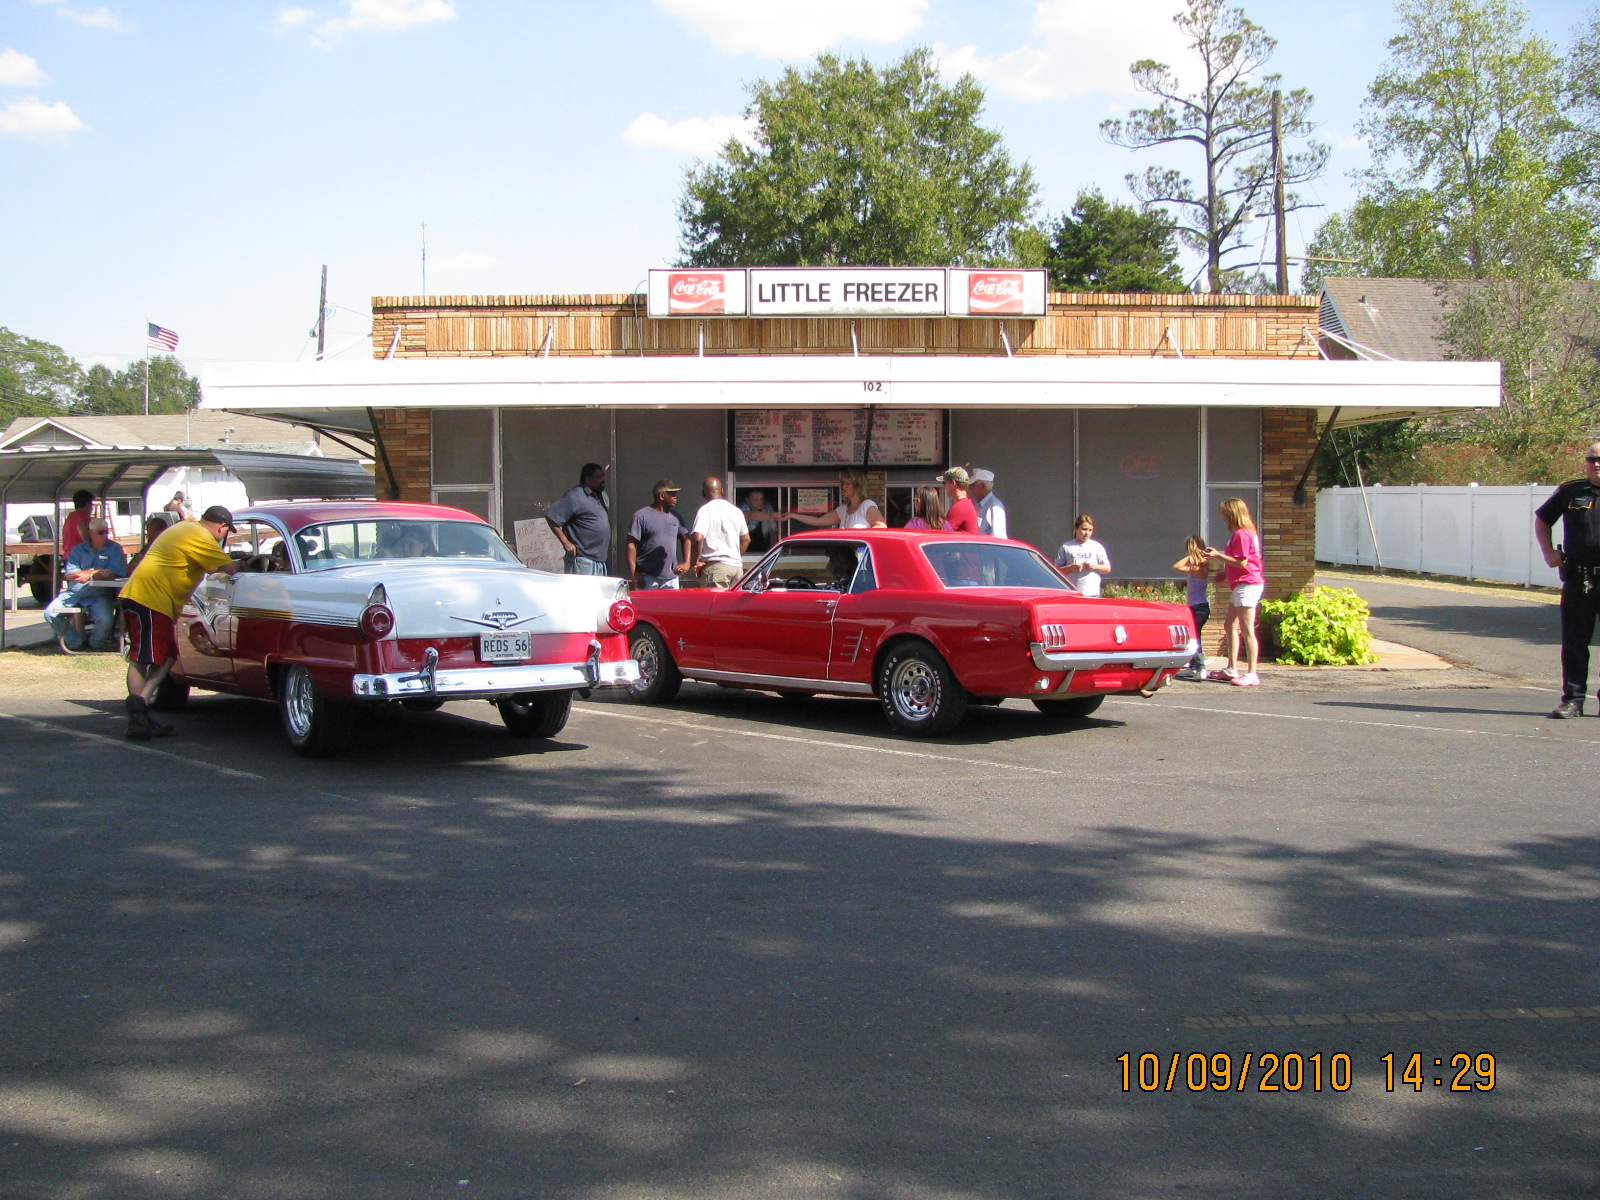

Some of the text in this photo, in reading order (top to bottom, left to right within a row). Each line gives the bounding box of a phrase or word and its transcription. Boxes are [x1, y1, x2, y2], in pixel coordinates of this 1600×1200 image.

[673, 279, 722, 296] Coca-Cola
[758, 282, 939, 303] LITTLE FREEZER
[973, 279, 1020, 296] Coca-Cola
[863, 381, 882, 392] 102
[483, 639, 528, 653] REDS 56
